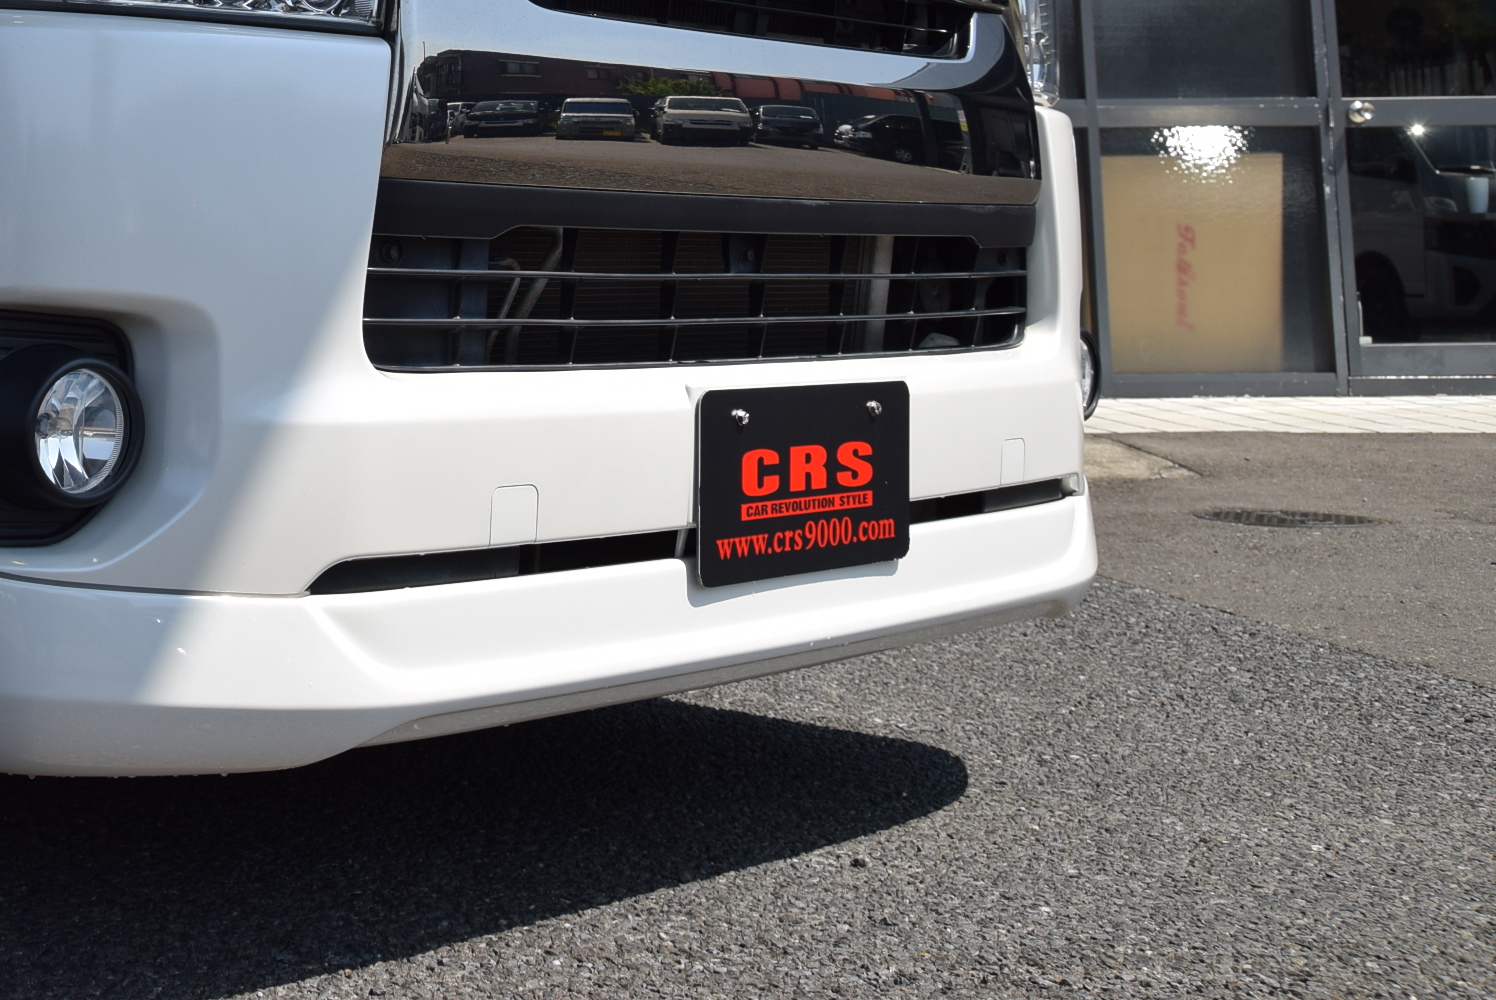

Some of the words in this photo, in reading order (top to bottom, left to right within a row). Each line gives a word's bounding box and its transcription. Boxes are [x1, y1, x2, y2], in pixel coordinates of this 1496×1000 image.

[741, 440, 874, 497] CRS
[746, 504, 768, 518] CAR
[770, 496, 836, 515] REVOLUTION
[839, 493, 869, 507] STYLE
[716, 516, 896, 560] www.crs9000.com
